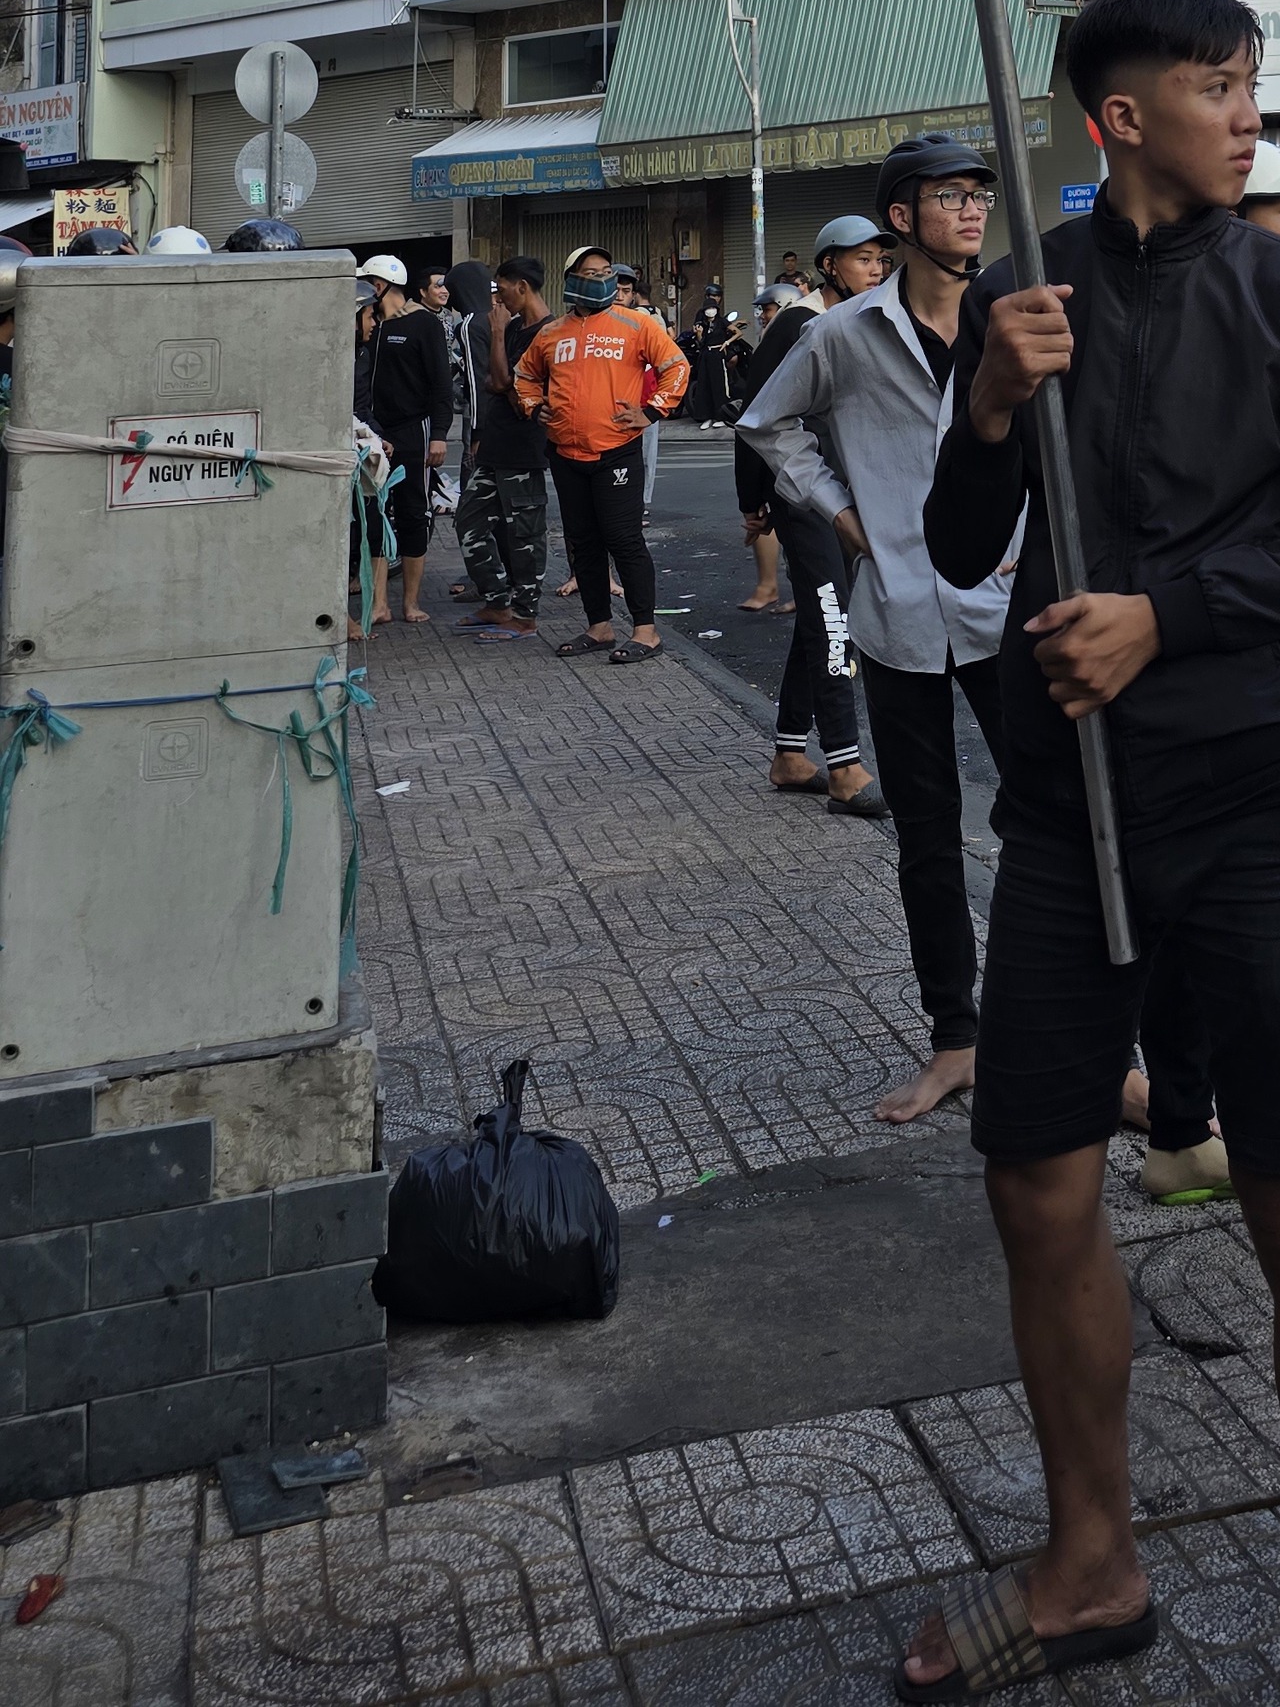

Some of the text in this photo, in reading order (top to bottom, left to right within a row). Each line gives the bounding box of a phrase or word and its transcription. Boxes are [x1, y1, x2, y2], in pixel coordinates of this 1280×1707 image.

[19, 91, 73, 123] NGUYÊN
[623, 146, 645, 179] CỬA
[647, 146, 676, 176] HÀNG
[678, 142, 697, 173] VẢI
[761, 126, 838, 167] THUẬN
[842, 118, 909, 158] PHÁT
[450, 160, 496, 186] QUANG
[586, 333, 626, 346] Shopee
[583, 345, 624, 361] Food
[149, 463, 195, 483] NGUY
